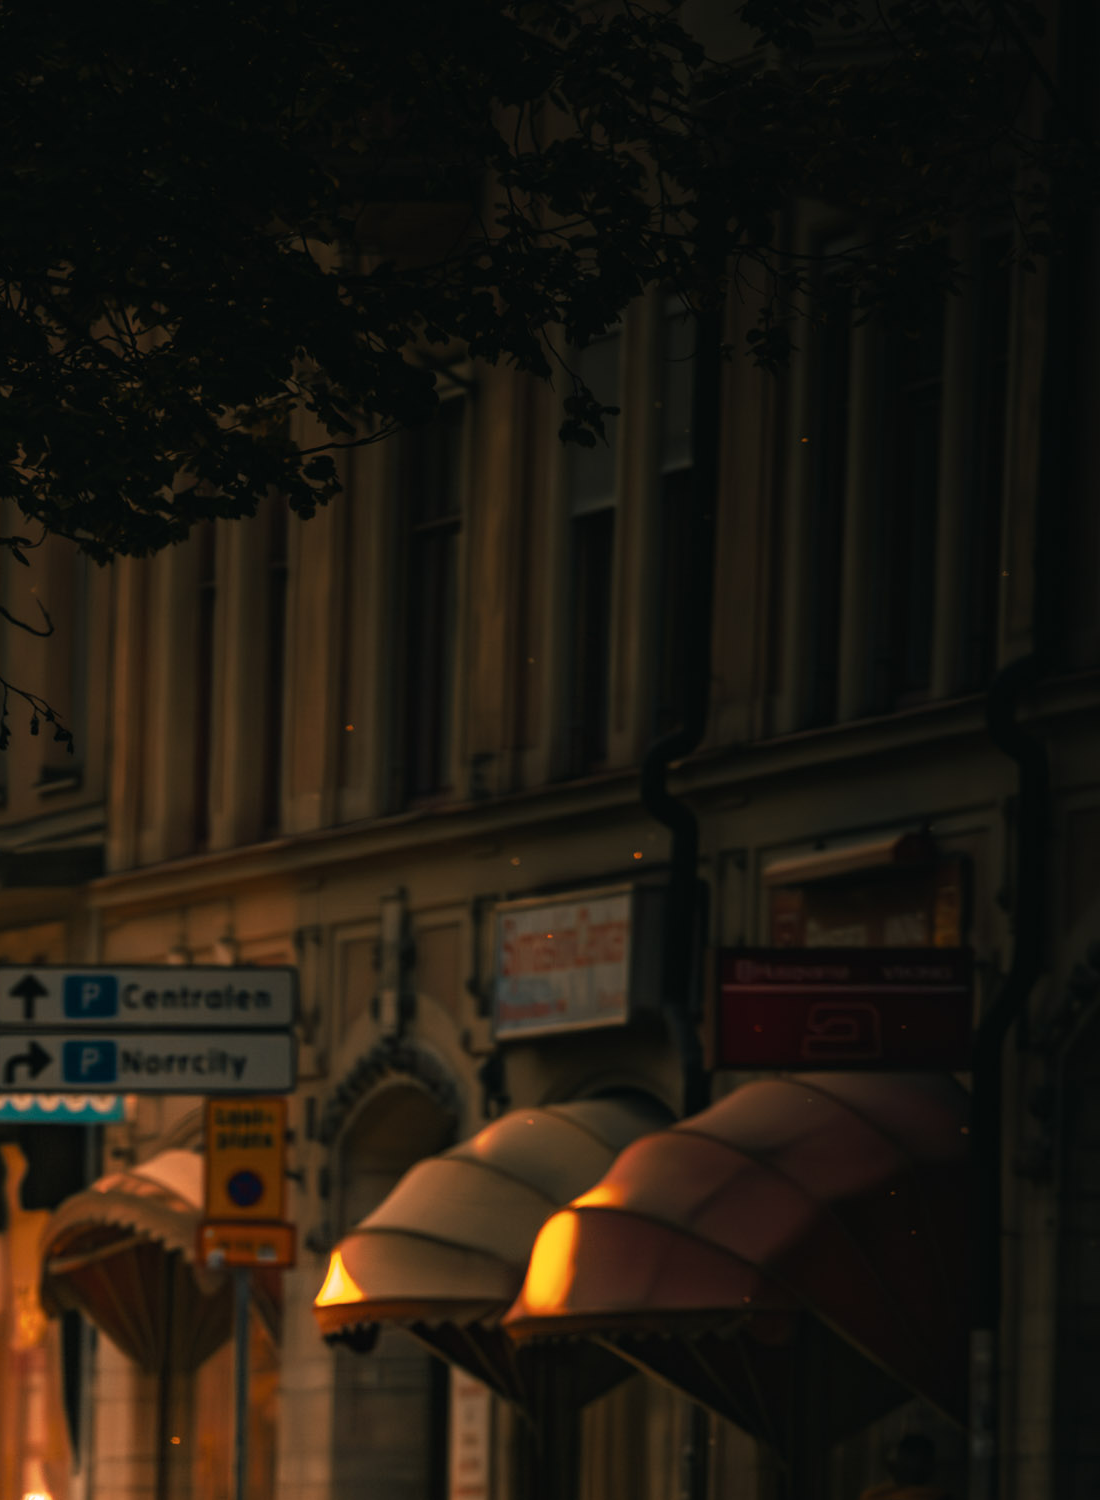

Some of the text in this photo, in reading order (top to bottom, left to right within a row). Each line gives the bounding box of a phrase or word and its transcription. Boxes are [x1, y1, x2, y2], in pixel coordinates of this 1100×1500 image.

[81, 982, 273, 1010] P Centralen
[80, 1048, 248, 1079] P Norrcity
